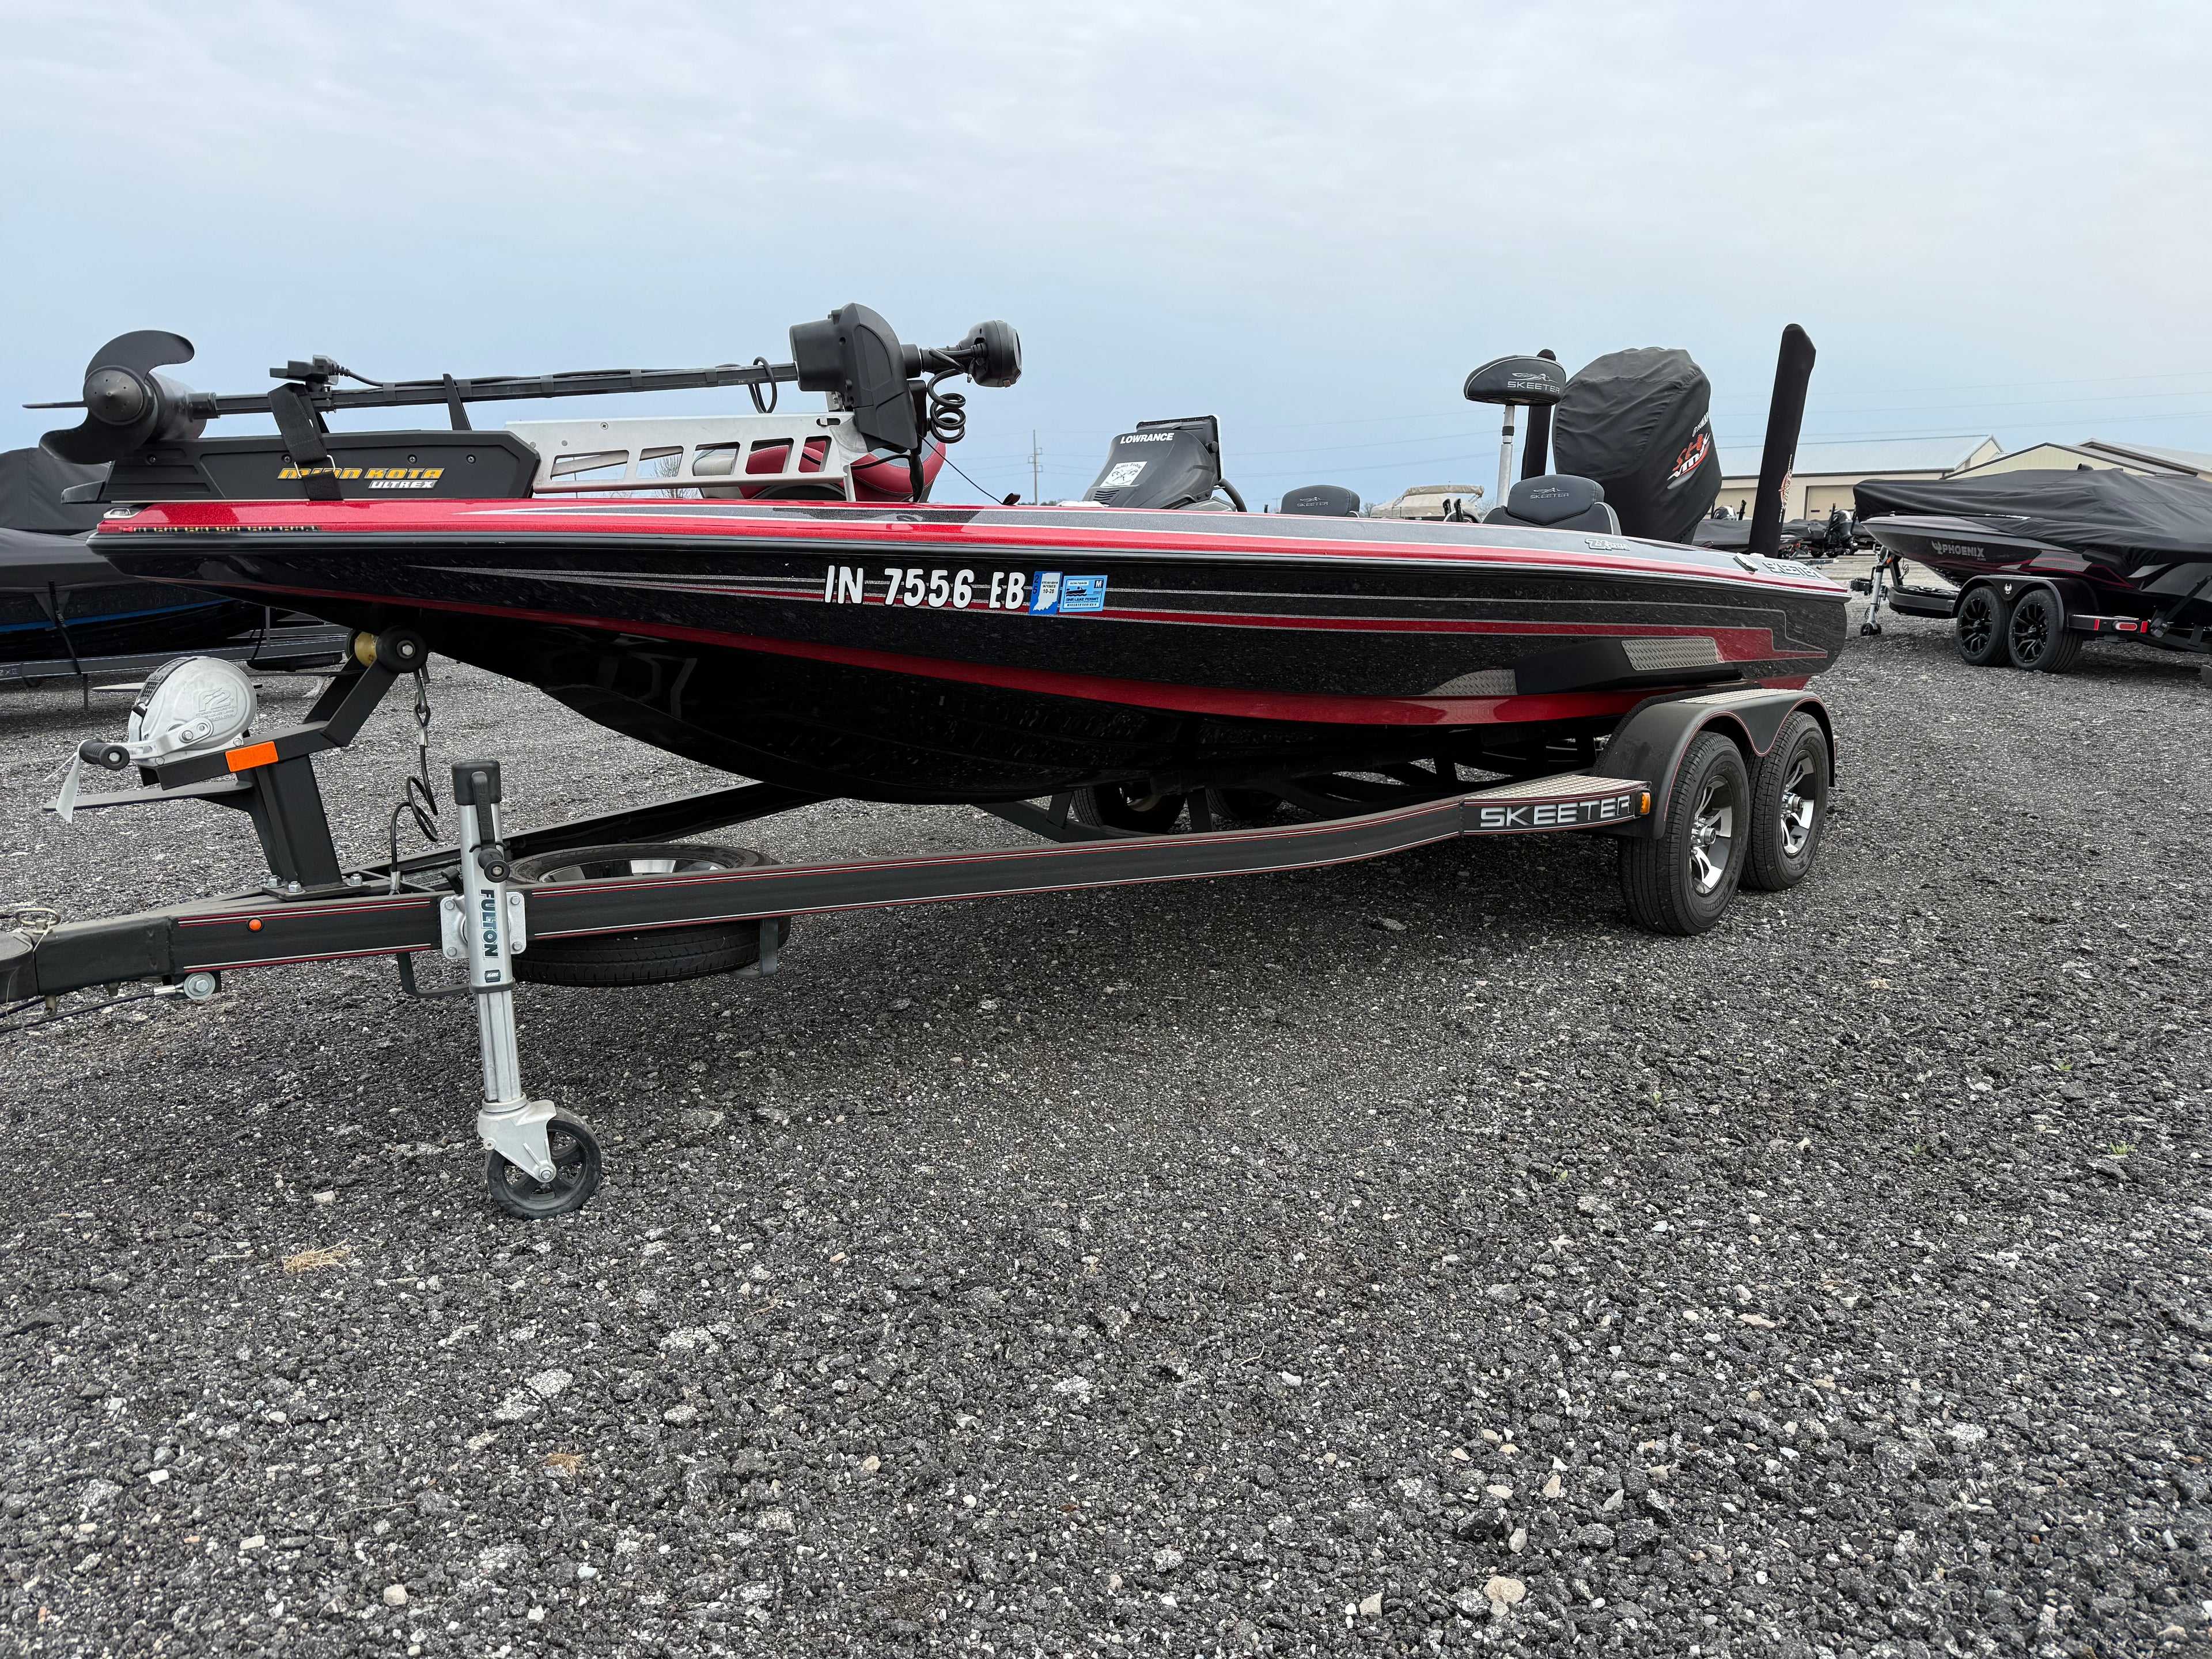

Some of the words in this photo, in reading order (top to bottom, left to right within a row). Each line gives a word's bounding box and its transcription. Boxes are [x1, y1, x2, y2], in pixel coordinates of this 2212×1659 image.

[1507, 381, 1560, 394] SKEETER
[1120, 433, 1175, 444] LOWRANCE
[364, 468, 445, 479] KOTA
[369, 480, 438, 489] ULTREX
[1942, 544, 1985, 558] PHOENIX
[824, 565, 863, 604] IN
[884, 568, 975, 609] 7556
[989, 571, 1025, 609] EB
[1095, 580, 1102, 588] M
[1480, 794, 1631, 827] SKEETER
[479, 888, 499, 959] FULTON
